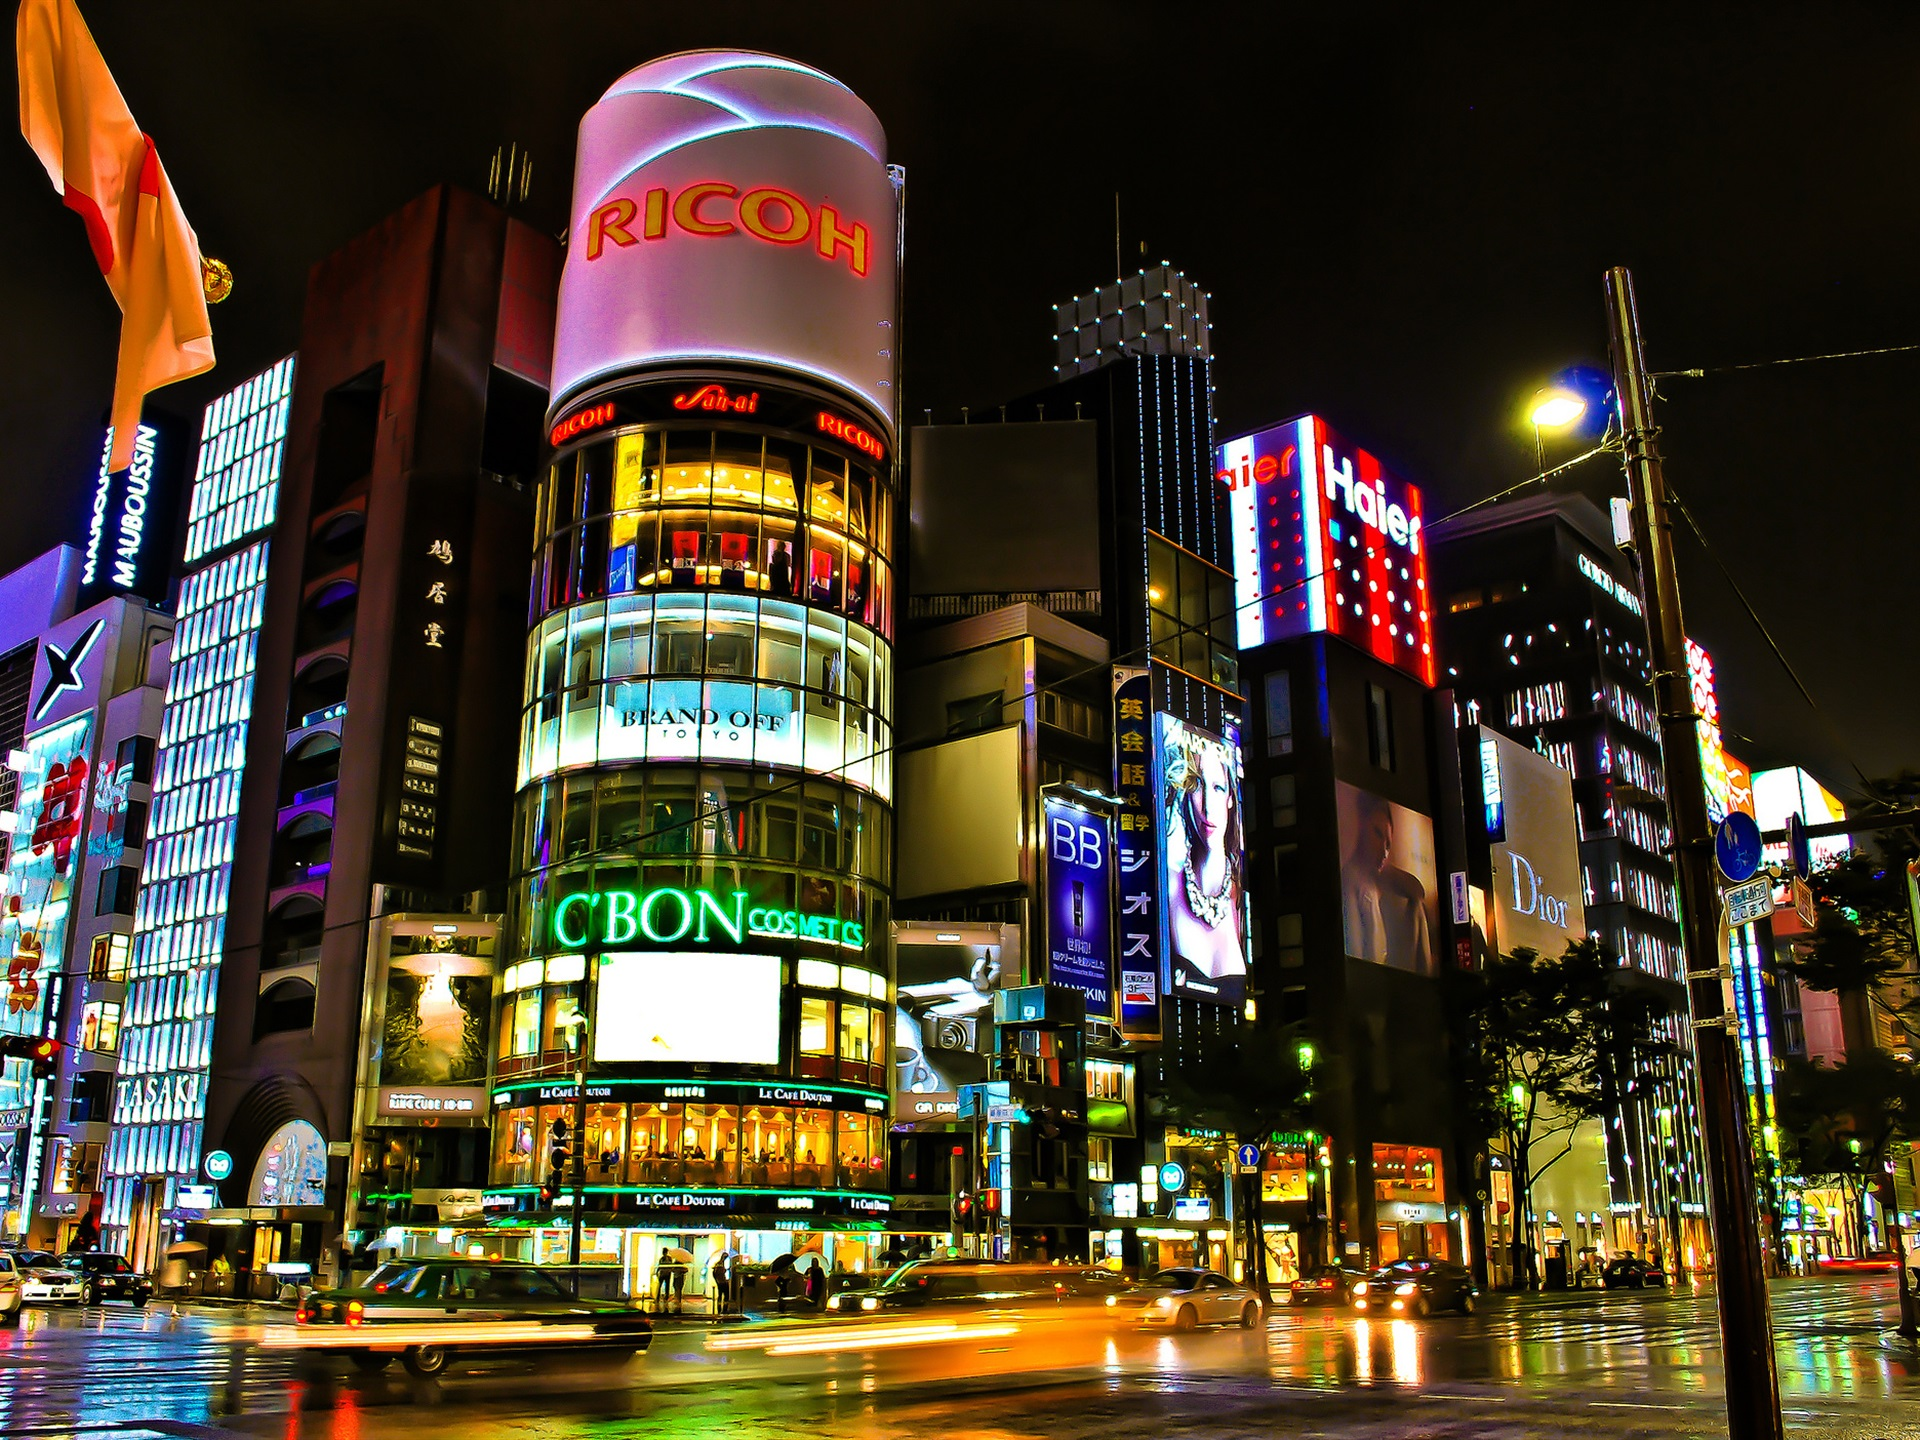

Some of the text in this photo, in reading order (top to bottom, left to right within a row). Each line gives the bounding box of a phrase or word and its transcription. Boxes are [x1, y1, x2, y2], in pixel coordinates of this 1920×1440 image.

[587, 182, 867, 277] RICOH
[551, 402, 614, 446] RICOH
[674, 385, 758, 413] San-ai
[817, 411, 883, 460] RICOH
[1216, 444, 1296, 492] aier
[112, 424, 158, 588] MAUBOUSSIN
[1323, 444, 1421, 555] Haier
[621, 708, 785, 732] BRAND OFF
[663, 729, 739, 741] TOYO
[1119, 698, 1145, 787] 英会話
[1053, 817, 1102, 870] B.B
[1121, 850, 1153, 958] ジオス
[1507, 851, 1568, 929] Dior
[554, 887, 864, 947] C'BON COSMETCS
[117, 1073, 200, 1108] TASAKI
[636, 1194, 650, 1206] LE
[683, 1194, 725, 1206] DOUTOR
